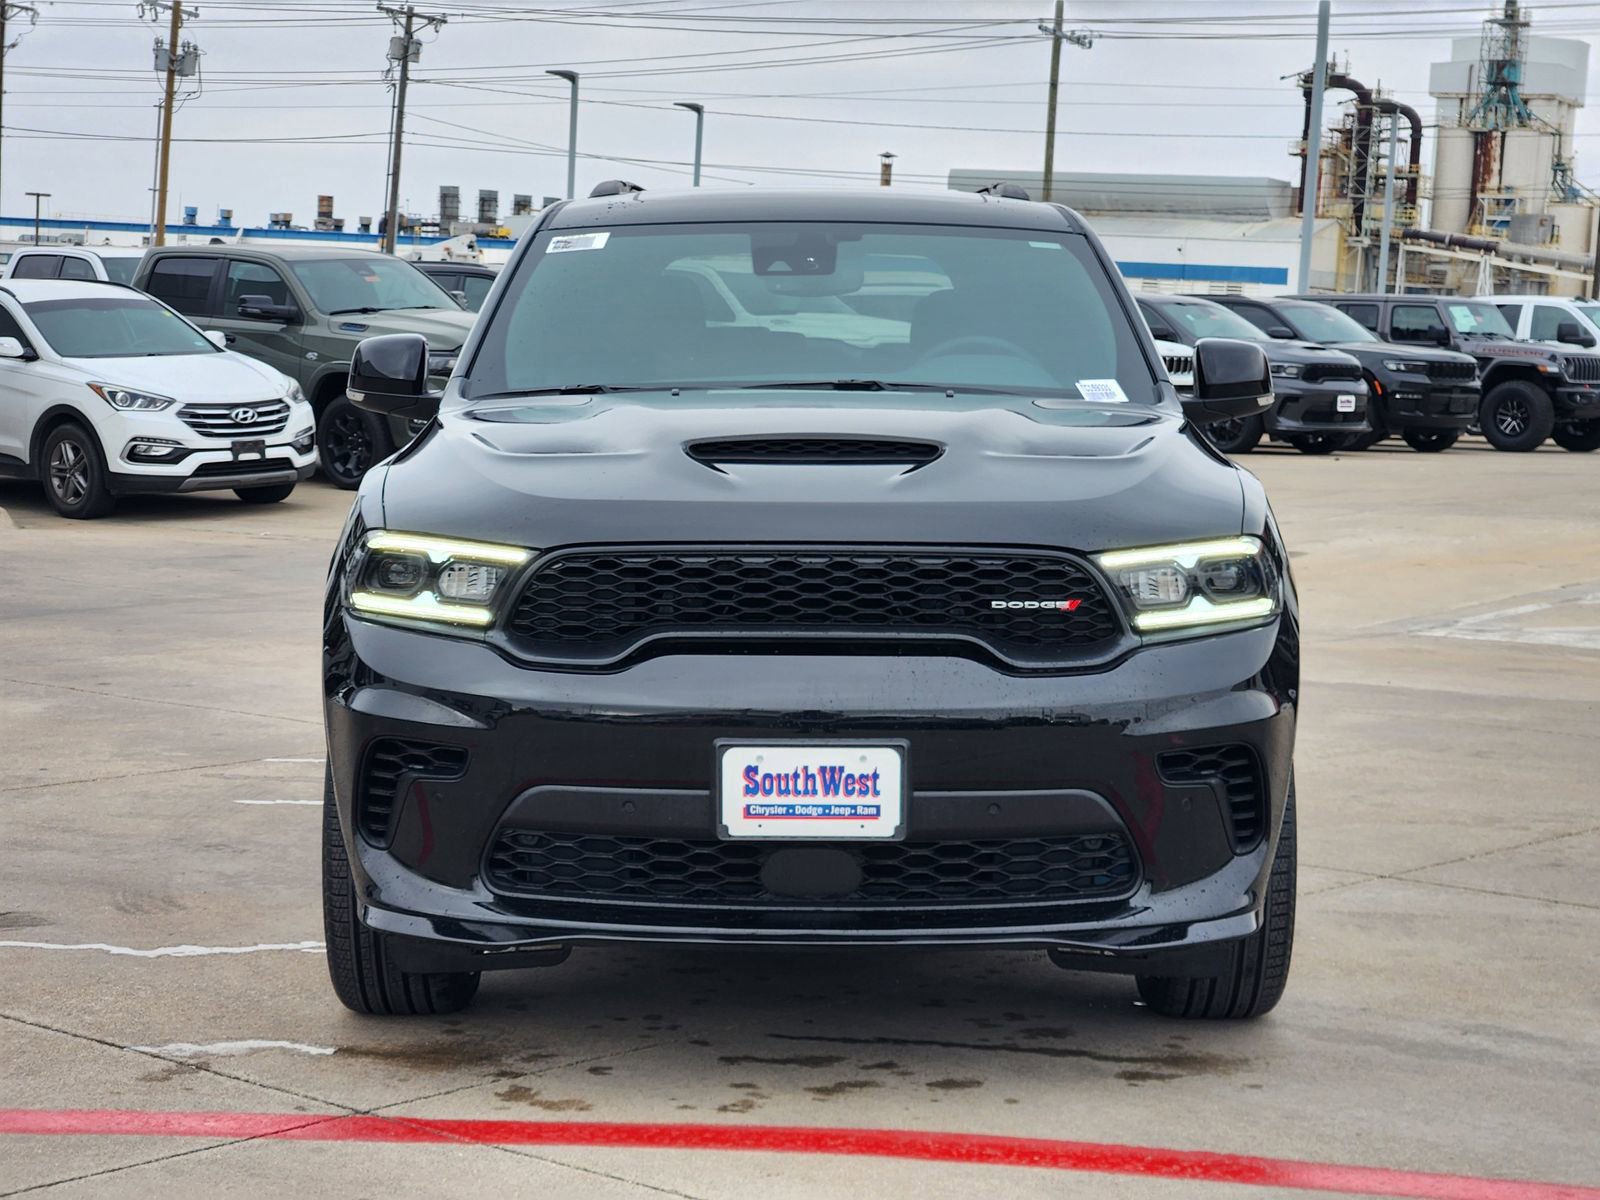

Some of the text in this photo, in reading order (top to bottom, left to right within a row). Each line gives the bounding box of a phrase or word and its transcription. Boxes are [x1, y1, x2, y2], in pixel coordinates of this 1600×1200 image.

[991, 600, 1069, 610] DODGE
[743, 764, 880, 797] SouthWest
[749, 804, 877, 817] Chrysler Dodge Jeep Ram
